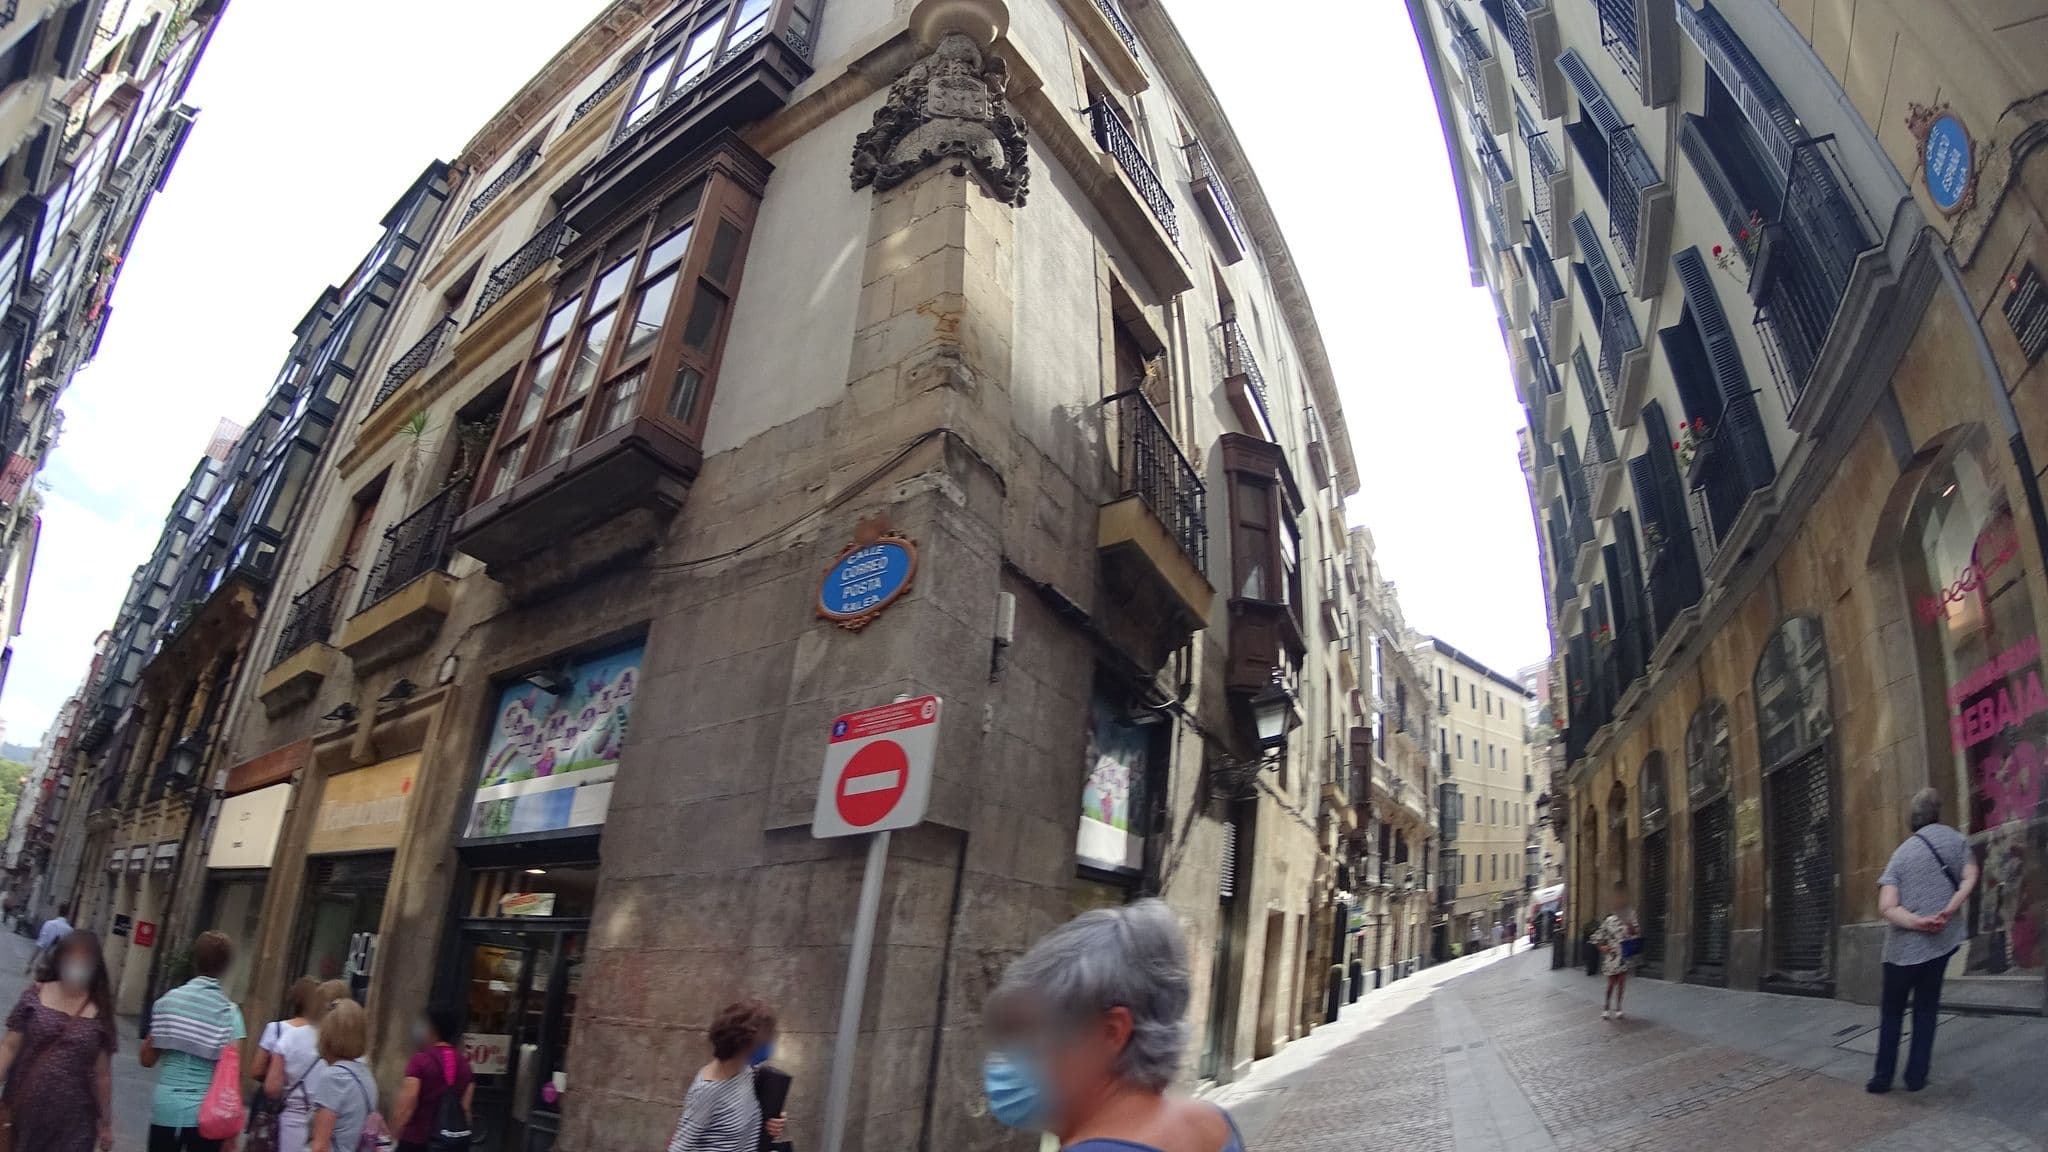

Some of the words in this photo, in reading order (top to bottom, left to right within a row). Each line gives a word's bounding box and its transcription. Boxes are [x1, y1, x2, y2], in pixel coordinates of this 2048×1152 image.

[847, 545, 885, 564] CALLE
[842, 556, 889, 580] CORREO
[842, 577, 881, 599] POSTA
